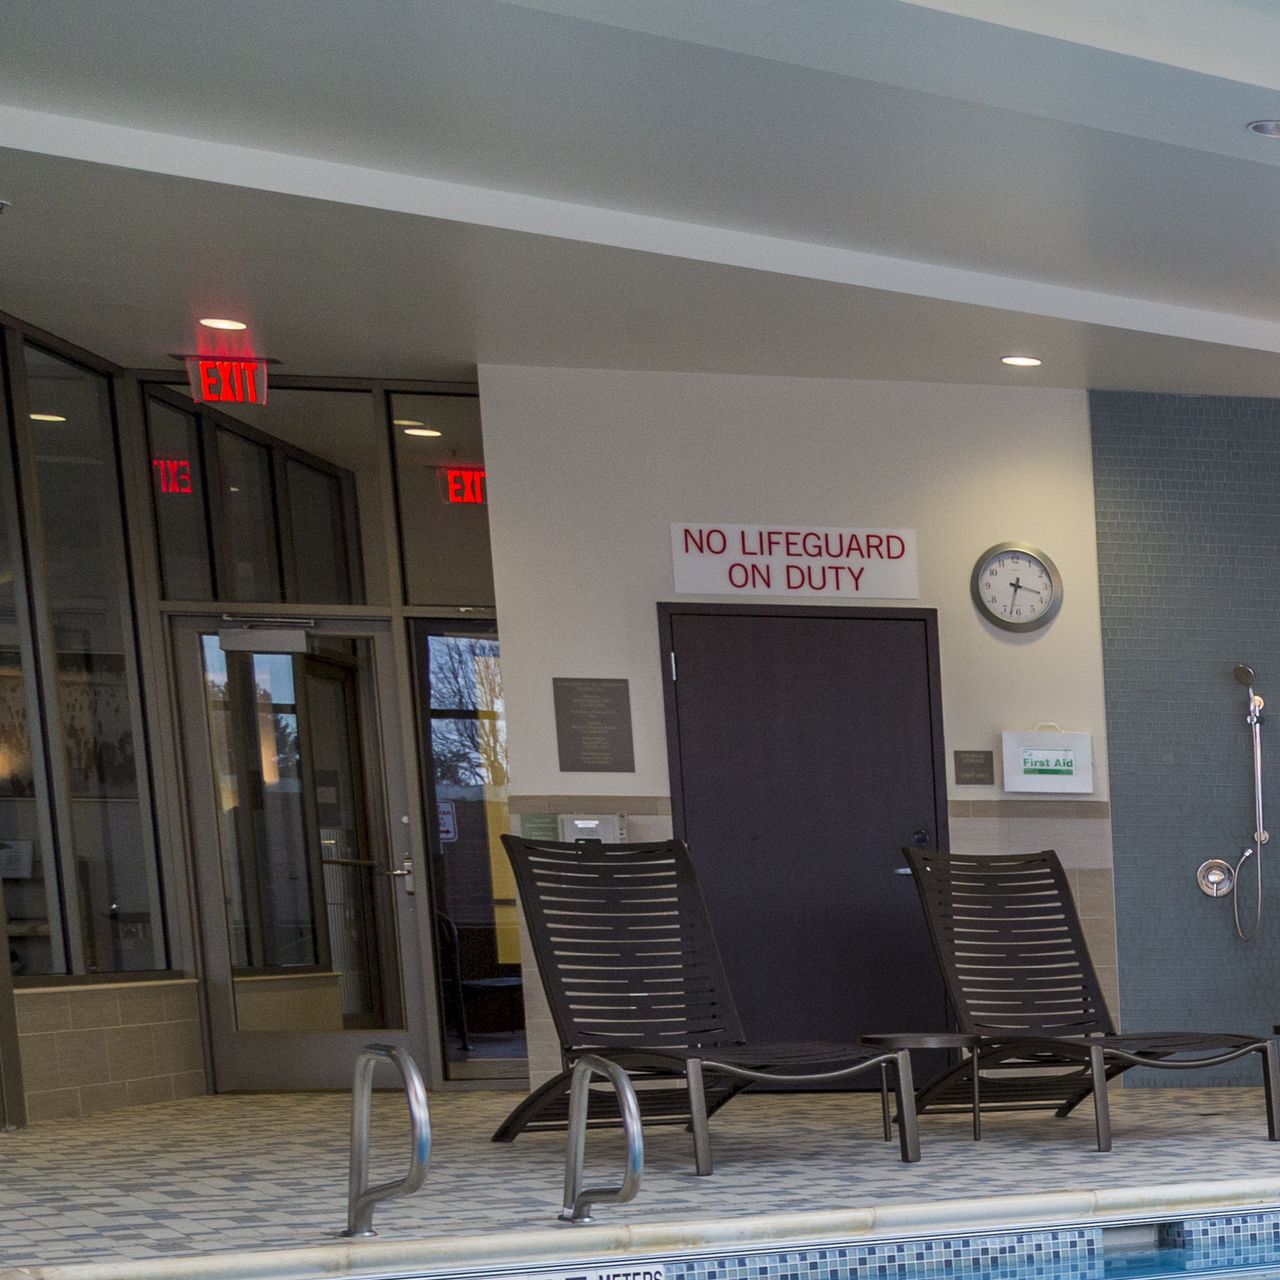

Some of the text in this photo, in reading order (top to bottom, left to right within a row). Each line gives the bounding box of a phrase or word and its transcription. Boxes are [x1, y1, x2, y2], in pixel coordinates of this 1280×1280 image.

[200, 361, 258, 403] EXIT
[684, 528, 906, 560] NO LIFEGUARD
[728, 563, 865, 591] ON DUTY
[1023, 758, 1073, 767] First Aid
